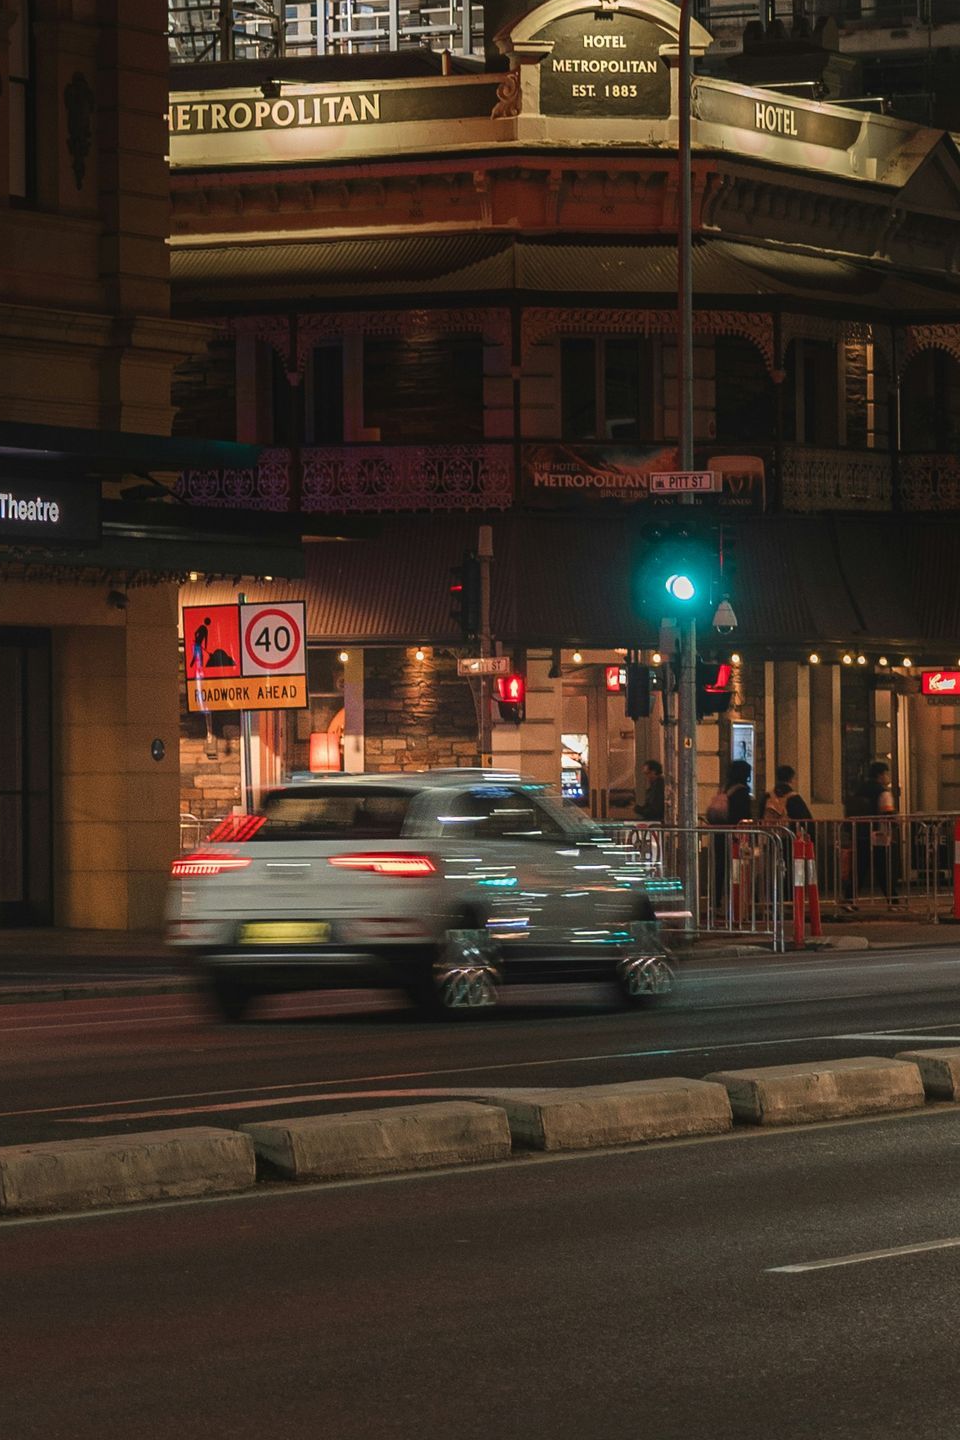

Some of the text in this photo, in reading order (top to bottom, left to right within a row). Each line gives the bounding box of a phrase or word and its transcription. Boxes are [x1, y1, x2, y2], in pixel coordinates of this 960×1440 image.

[583, 35, 626, 49] HOTEL
[552, 59, 657, 74] METROPOLITAN
[572, 84, 638, 97] EST. 1883
[755, 102, 798, 135] HOTEL
[534, 462, 581, 472] THE HOTEL
[533, 472, 648, 488] METROPOLITAN
[669, 476, 704, 488] PITT ST
[600, 488, 628, 498] SINCE
[254, 626, 291, 652] 40
[194, 684, 297, 703] ROADWORK AHEAD
